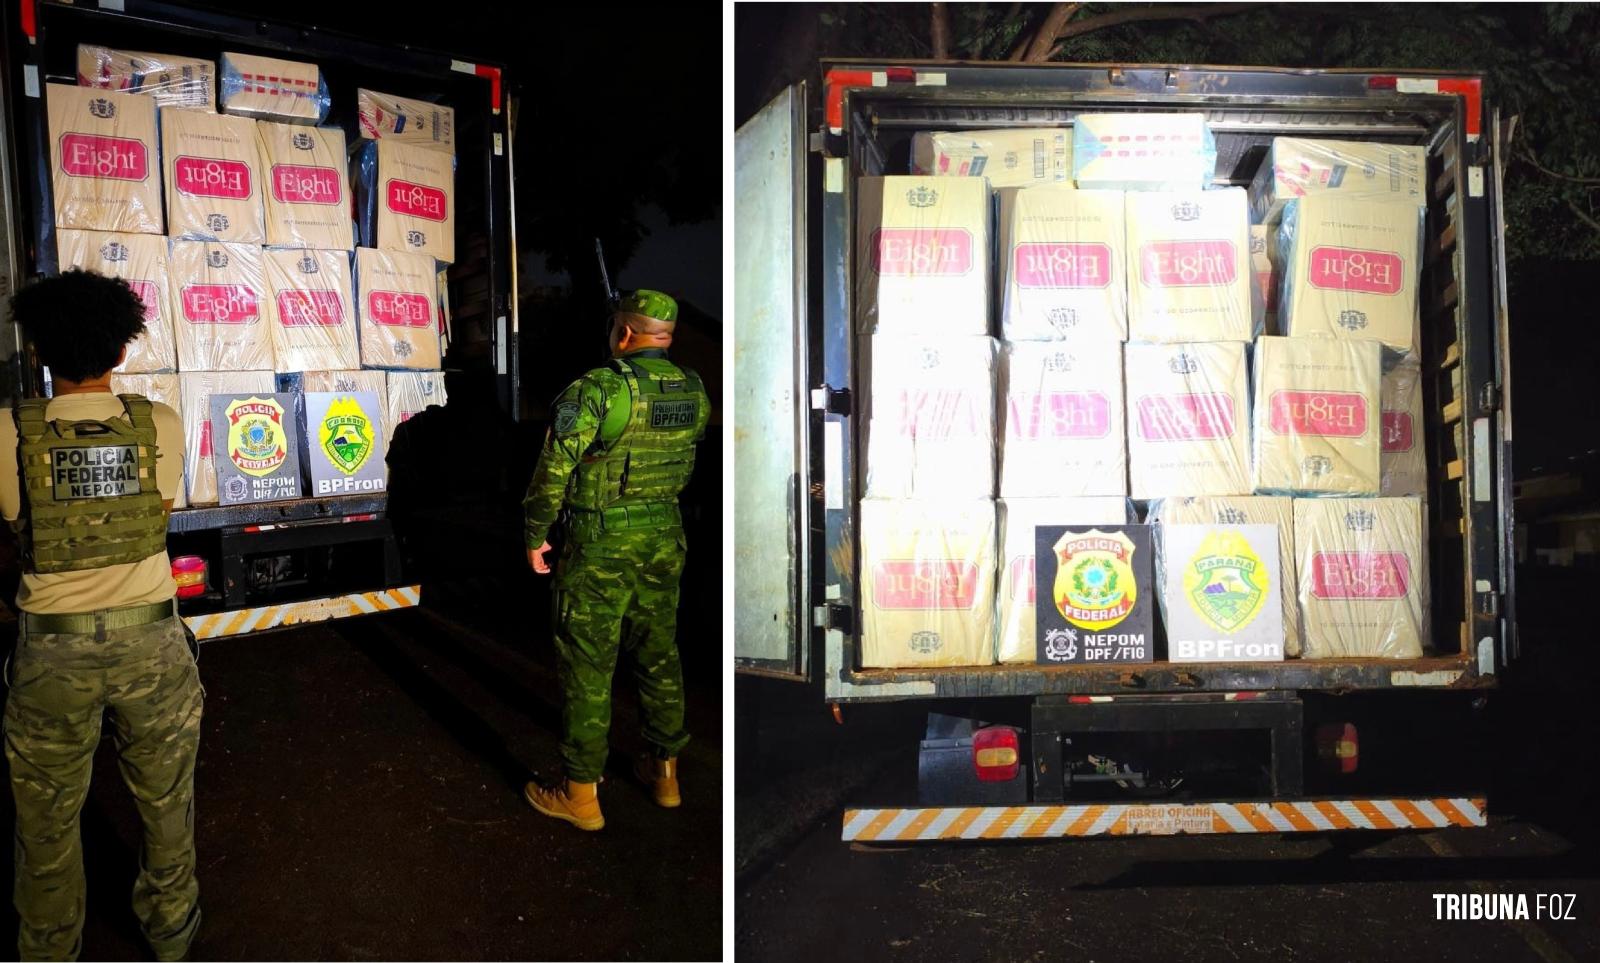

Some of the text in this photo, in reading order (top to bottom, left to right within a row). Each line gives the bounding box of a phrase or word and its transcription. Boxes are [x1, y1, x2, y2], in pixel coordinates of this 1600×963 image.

[71, 142, 137, 176] Eight
[185, 162, 244, 191] Eight
[279, 171, 334, 200] Eight
[395, 187, 441, 214] Eight
[883, 237, 960, 272] Eight
[1027, 247, 1101, 279] Eight
[1151, 250, 1225, 282] Eight
[1321, 253, 1393, 286] Eight
[191, 289, 252, 320] Eight
[1281, 396, 1357, 428] Eight
[55, 448, 135, 467] POLICIA
[56, 465, 137, 484] FEDERAL
[318, 477, 384, 494] BPFron
[70, 482, 126, 497] NEPOM
[1321, 558, 1397, 595] Eight
[1064, 603, 1126, 621] FEDERAL
[1084, 634, 1145, 647] NEPOM
[1084, 647, 1145, 661] DPF/FIG
[1178, 640, 1280, 658] BPFron
[1128, 806, 1211, 818] ABREU OFICINA
